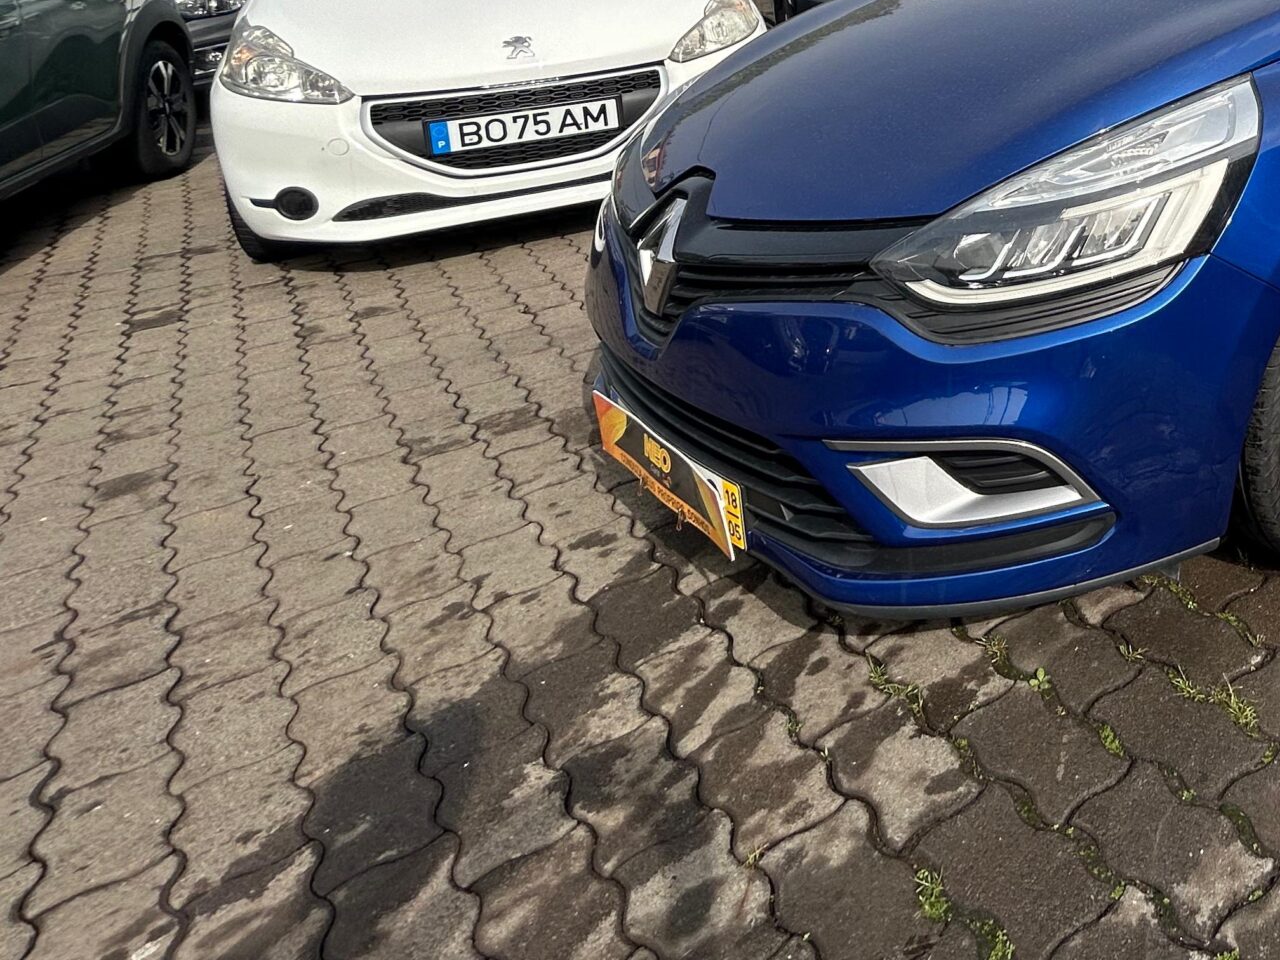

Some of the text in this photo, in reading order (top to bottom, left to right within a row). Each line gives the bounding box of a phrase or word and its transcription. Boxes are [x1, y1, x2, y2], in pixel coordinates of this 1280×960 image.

[458, 103, 609, 148] BO 75 AM
[437, 140, 445, 149] P
[643, 432, 672, 473] NEO
[724, 489, 738, 509] 18
[728, 521, 742, 541] 05
